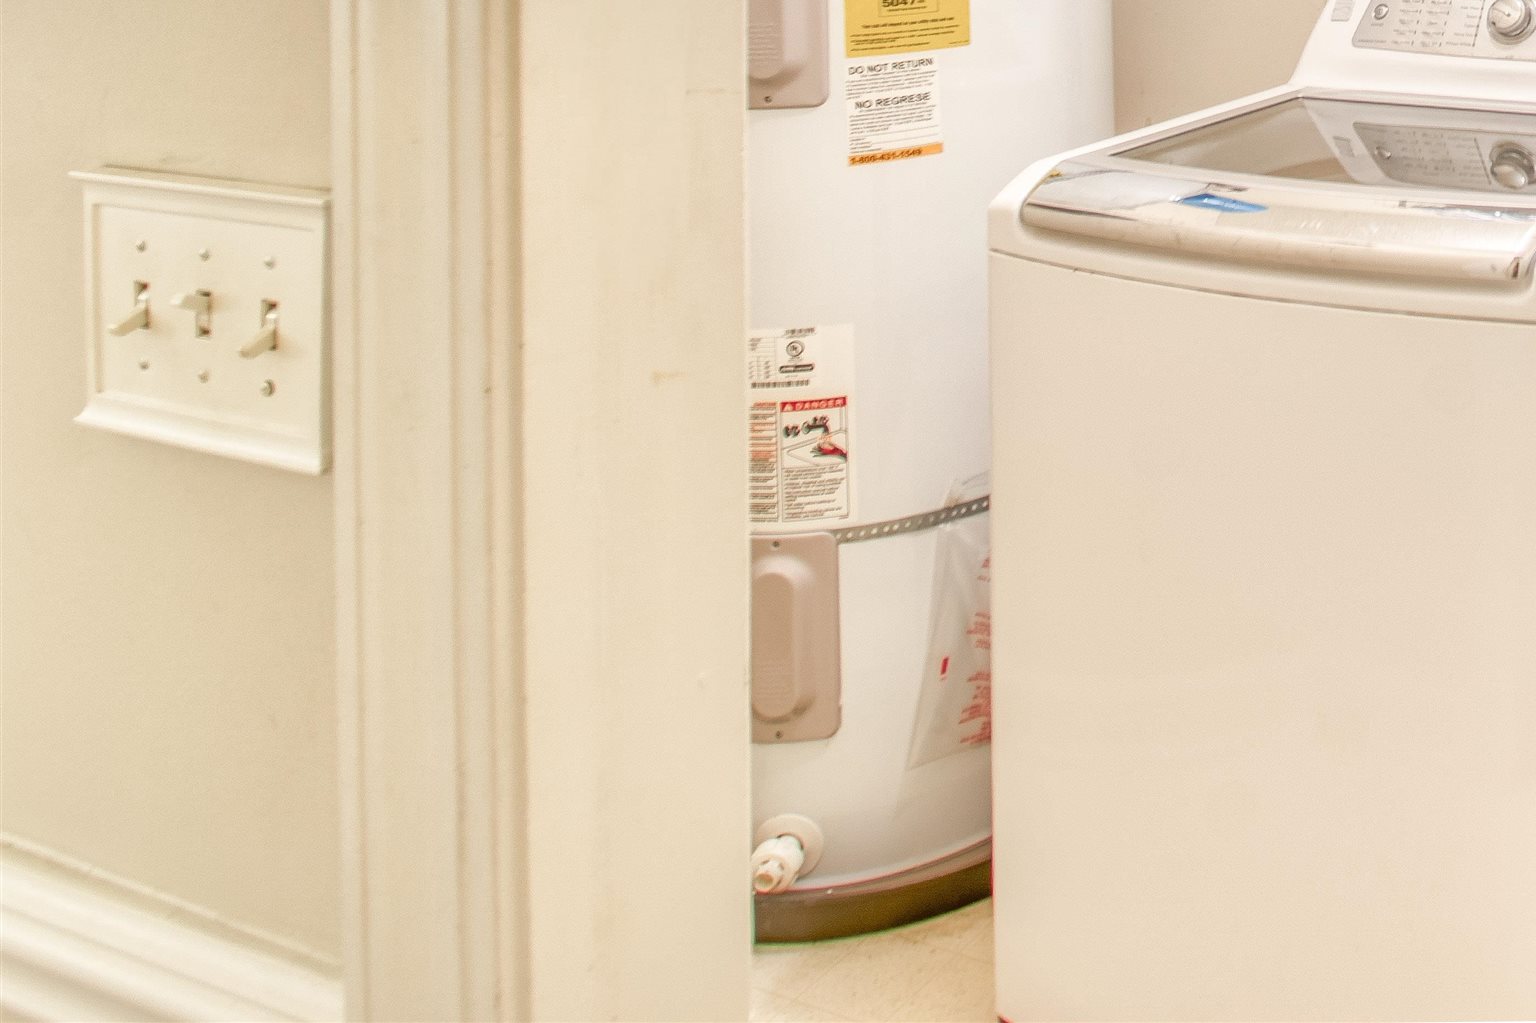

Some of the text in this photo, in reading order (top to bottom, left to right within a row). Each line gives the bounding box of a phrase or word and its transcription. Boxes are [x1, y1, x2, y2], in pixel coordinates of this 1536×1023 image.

[848, 57, 934, 76] DO NOT RETURN
[854, 92, 931, 110] NO REGRESE
[795, 397, 844, 411] DANGER
